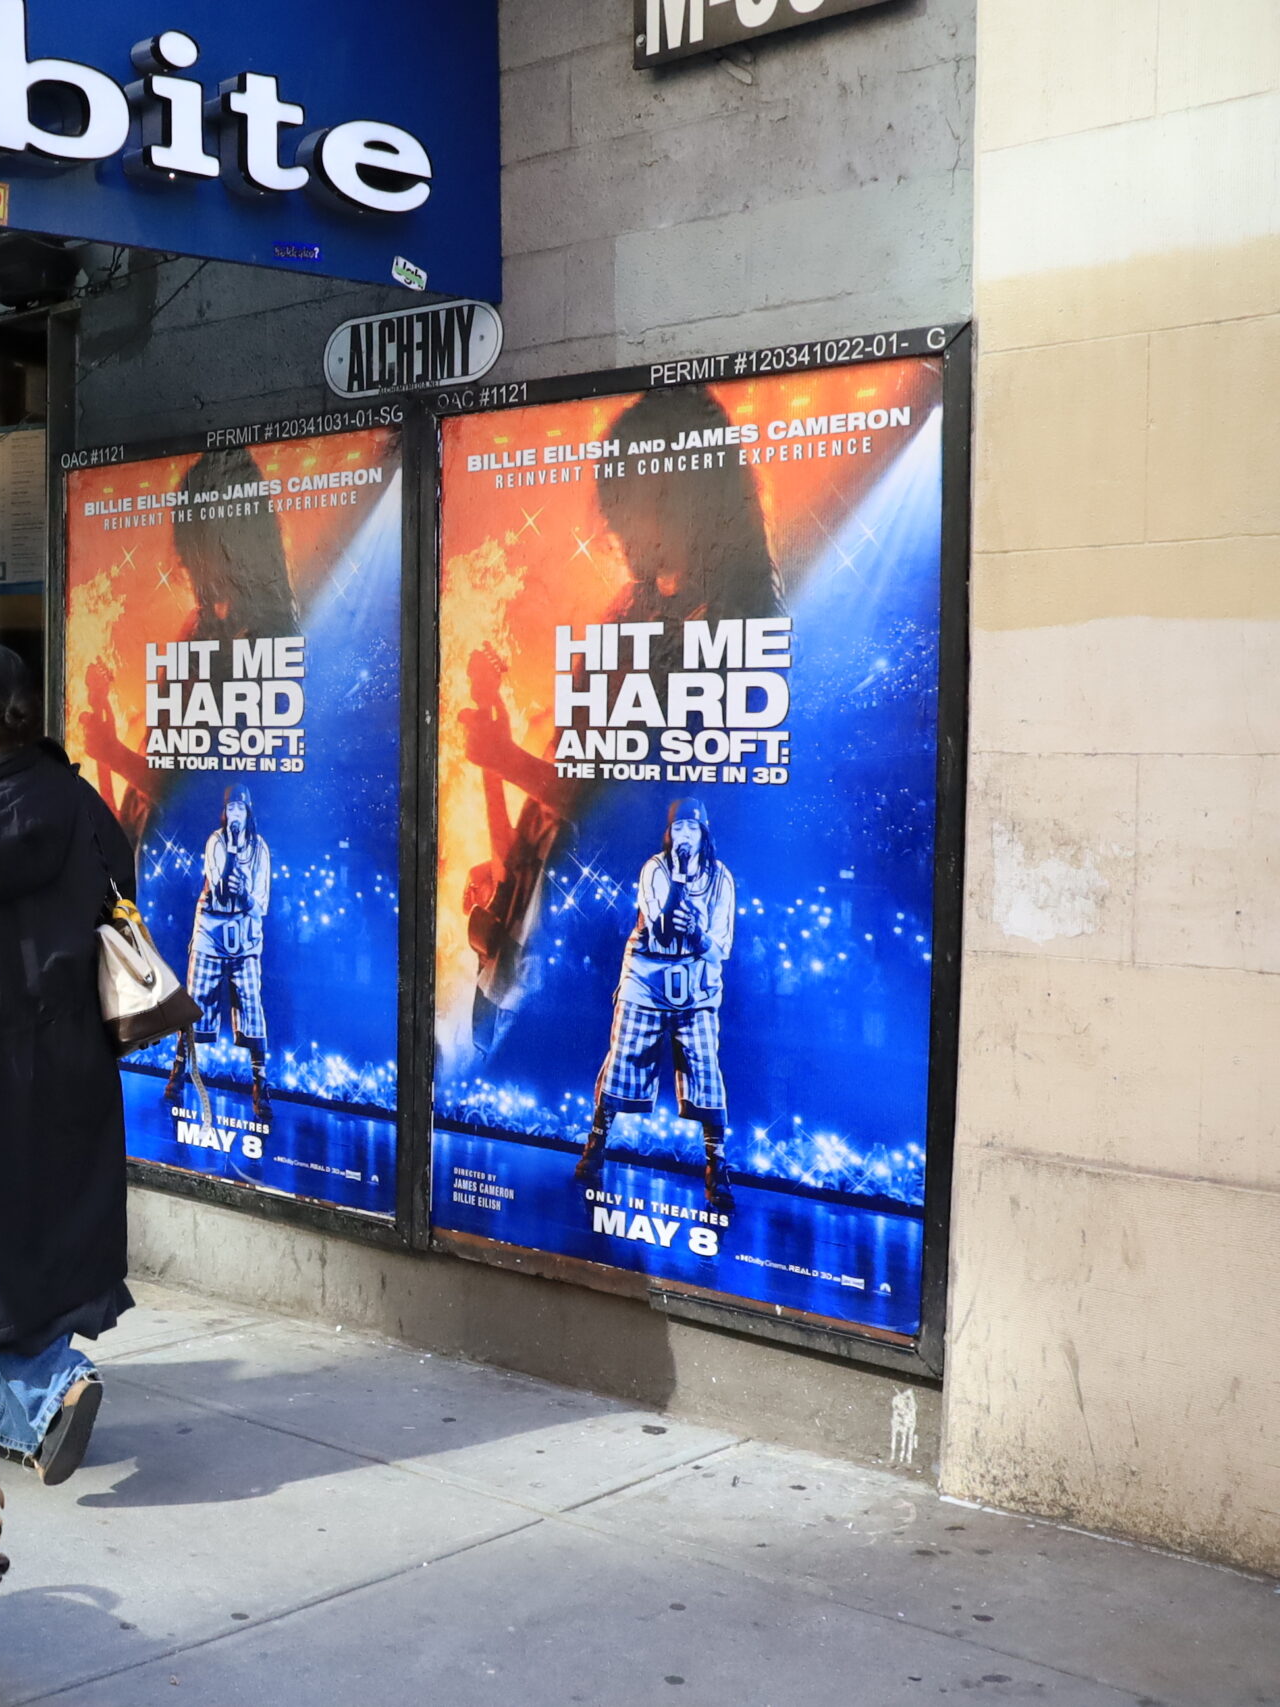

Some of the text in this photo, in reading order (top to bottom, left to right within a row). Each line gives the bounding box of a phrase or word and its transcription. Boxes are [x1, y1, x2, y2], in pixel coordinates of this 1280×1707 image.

[347, 304, 475, 393] ALCHEMY
[650, 356, 728, 385] PERMIT
[437, 383, 528, 409] OAC #1121
[61, 446, 125, 469] OAC #1121
[467, 406, 911, 473] BILLIE EILISH AND JAMES CAMERON
[495, 436, 873, 489] REINVENT THE CONCERT EXPERIENCE
[84, 467, 382, 517] BILLIE EILISH AND JAMES CAMERON
[103, 490, 357, 531] REINVENT THE CONCERT EXPERIENCE
[146, 637, 305, 681] HIT ME
[555, 617, 792, 671] HIT ME
[146, 681, 304, 727] HARD
[554, 671, 791, 728] HARD
[146, 728, 305, 756] AND SOFT:
[554, 729, 790, 764] AND SOFT:
[146, 756, 304, 772] THE TOUR LIVE IN 3D
[554, 763, 789, 784] THE TOUR LIVE IN 3D
[171, 1107, 197, 1121] ONLY
[217, 1114, 270, 1135] THEATRES
[177, 1121, 263, 1159] MAY 8
[453, 1167, 496, 1182] DIRECTED BY
[453, 1178, 514, 1200] JAMES CAMERON
[453, 1191, 501, 1211] BILLIE EILISH
[585, 1188, 729, 1228] ONLY IN THEATRES
[592, 1206, 719, 1257] MAY 8
[788, 1264, 811, 1277] REAL
[820, 1271, 833, 1281] 3D
